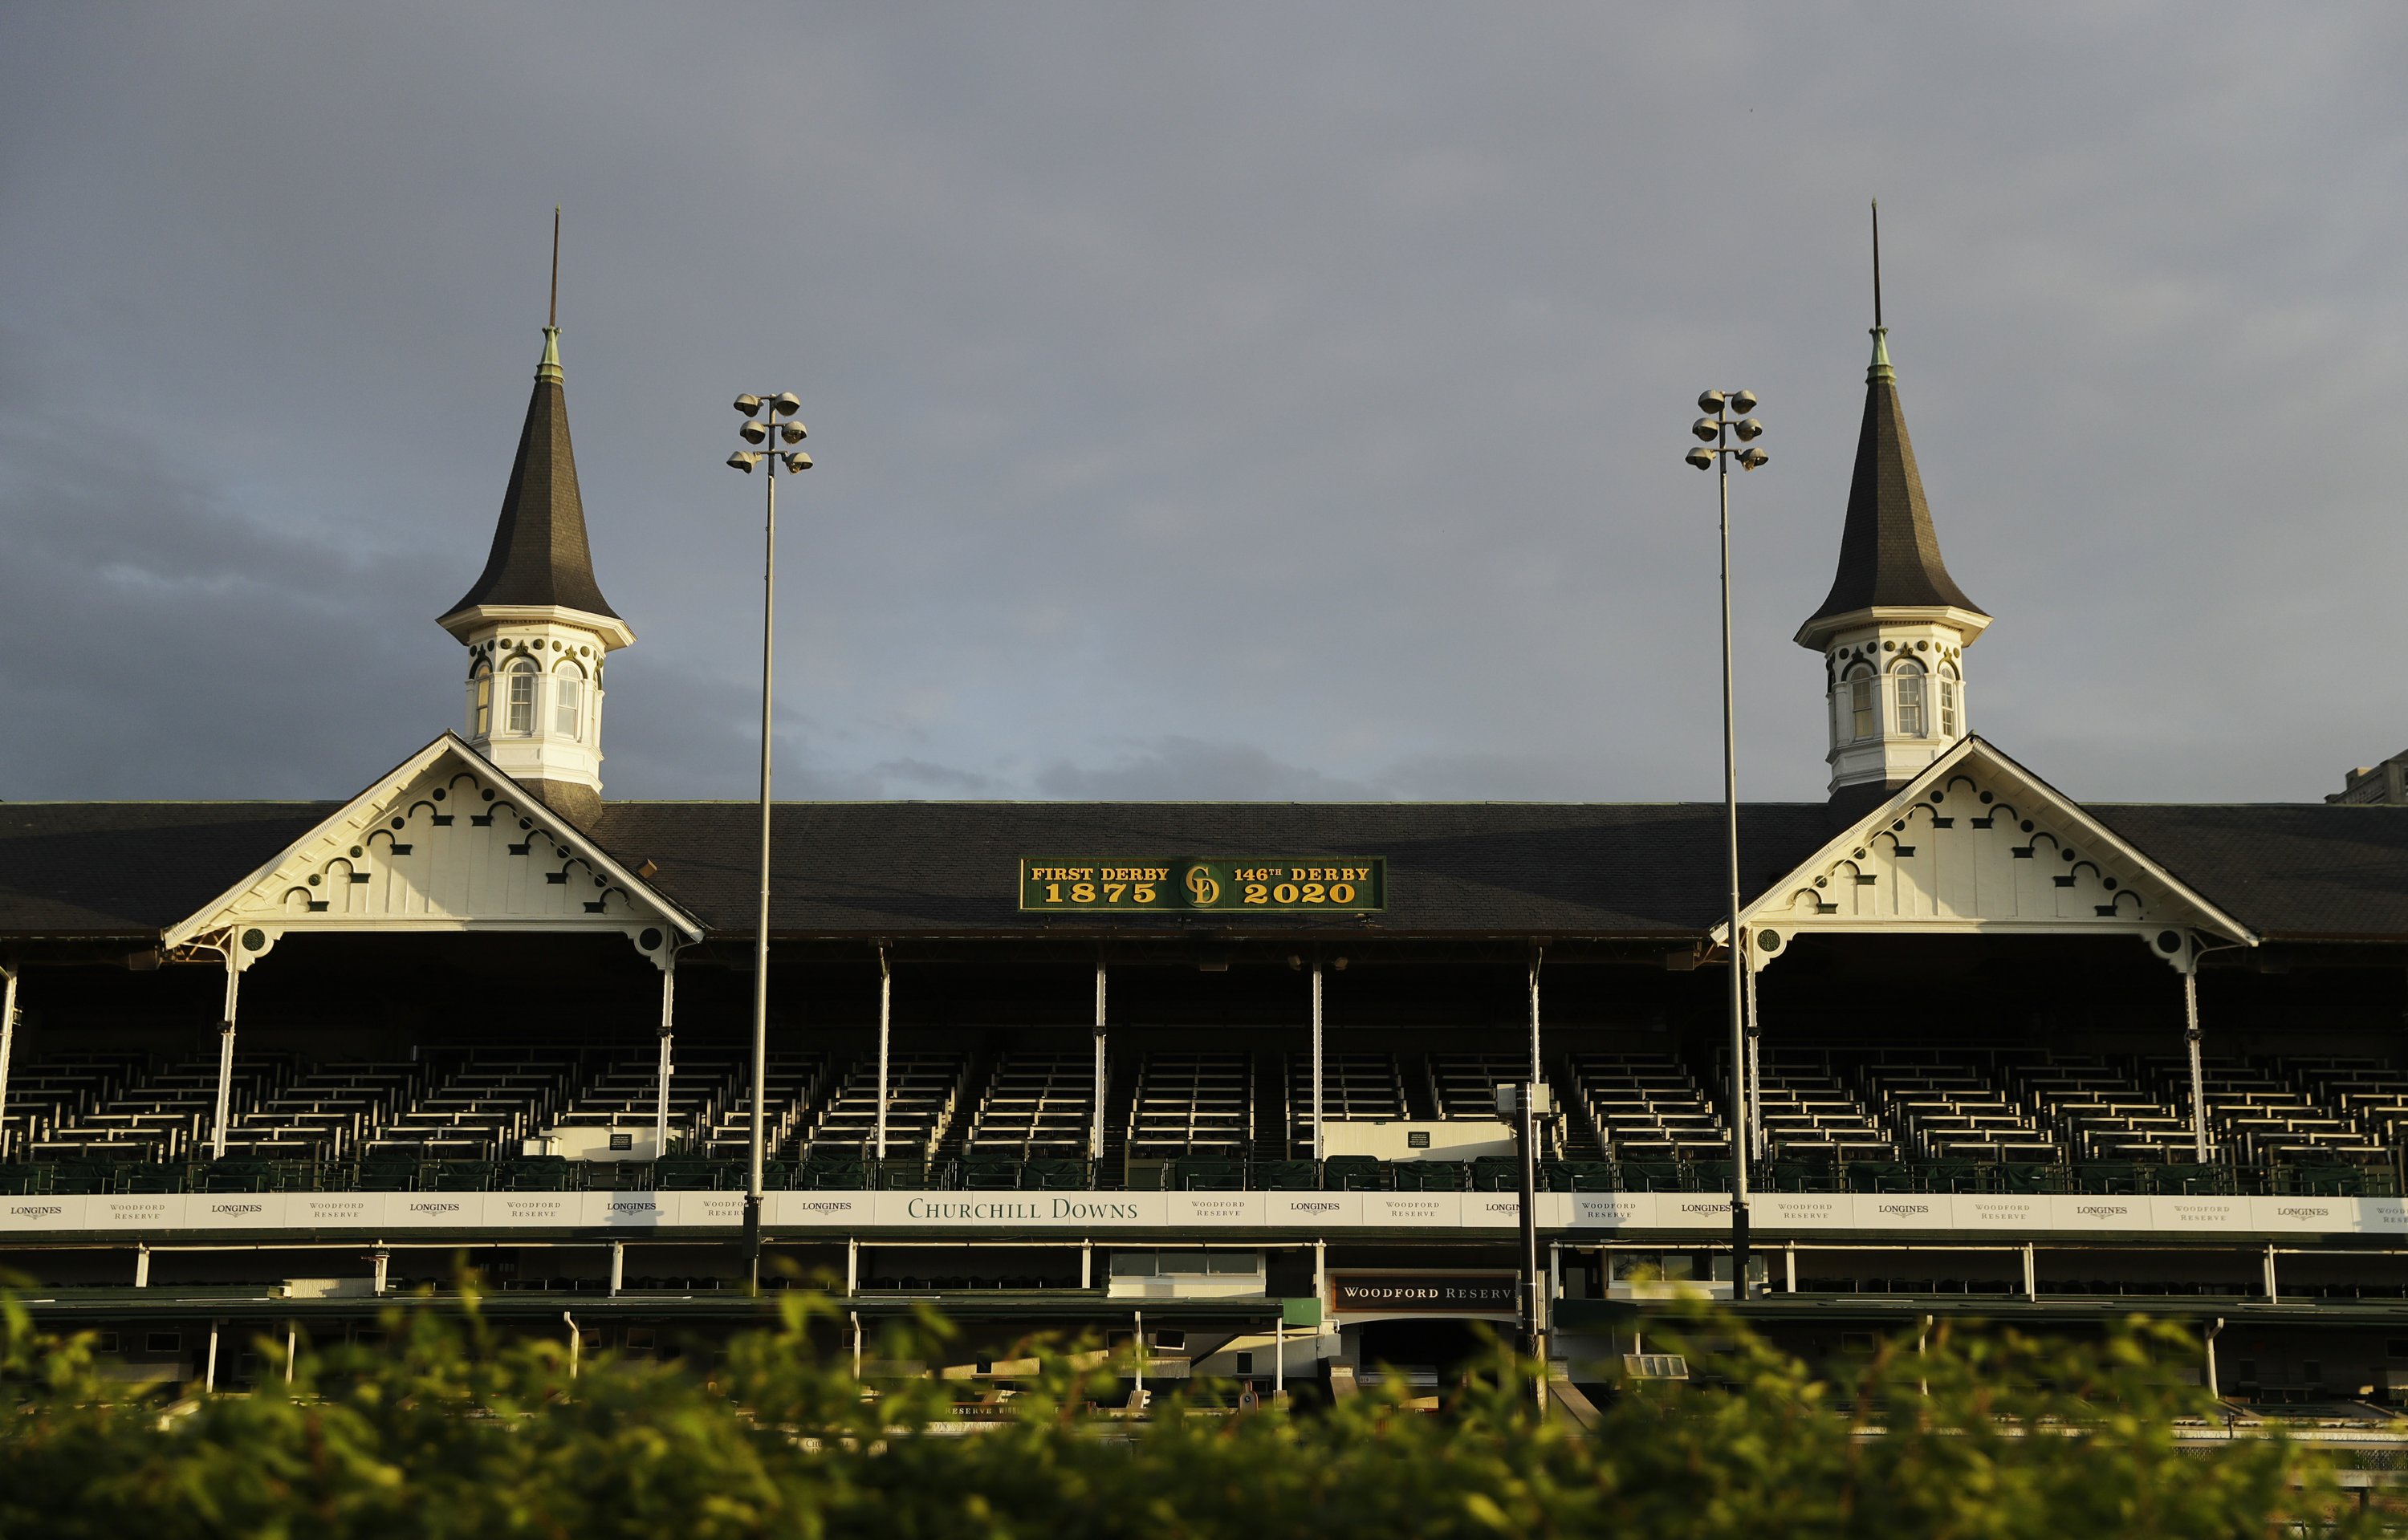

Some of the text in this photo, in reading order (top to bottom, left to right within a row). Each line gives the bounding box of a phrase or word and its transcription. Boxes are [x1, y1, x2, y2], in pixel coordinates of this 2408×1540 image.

[1031, 868, 1169, 881] FIRST DERBY
[1234, 868, 1369, 881] 146TH DERBY
[1045, 883, 1156, 904] 1875
[1244, 883, 1356, 904] 2020
[11, 1207, 62, 1215] LONGINES
[212, 1205, 262, 1213] LONGINES
[908, 1197, 1137, 1218] CHURCHILL DOWNS
[2076, 1207, 2128, 1215] LONGINES
[2277, 1208, 2329, 1216] LONGINES
[1344, 1286, 1515, 1298] WOODFORD RESERV
[945, 1407, 992, 1415] RESERVE
